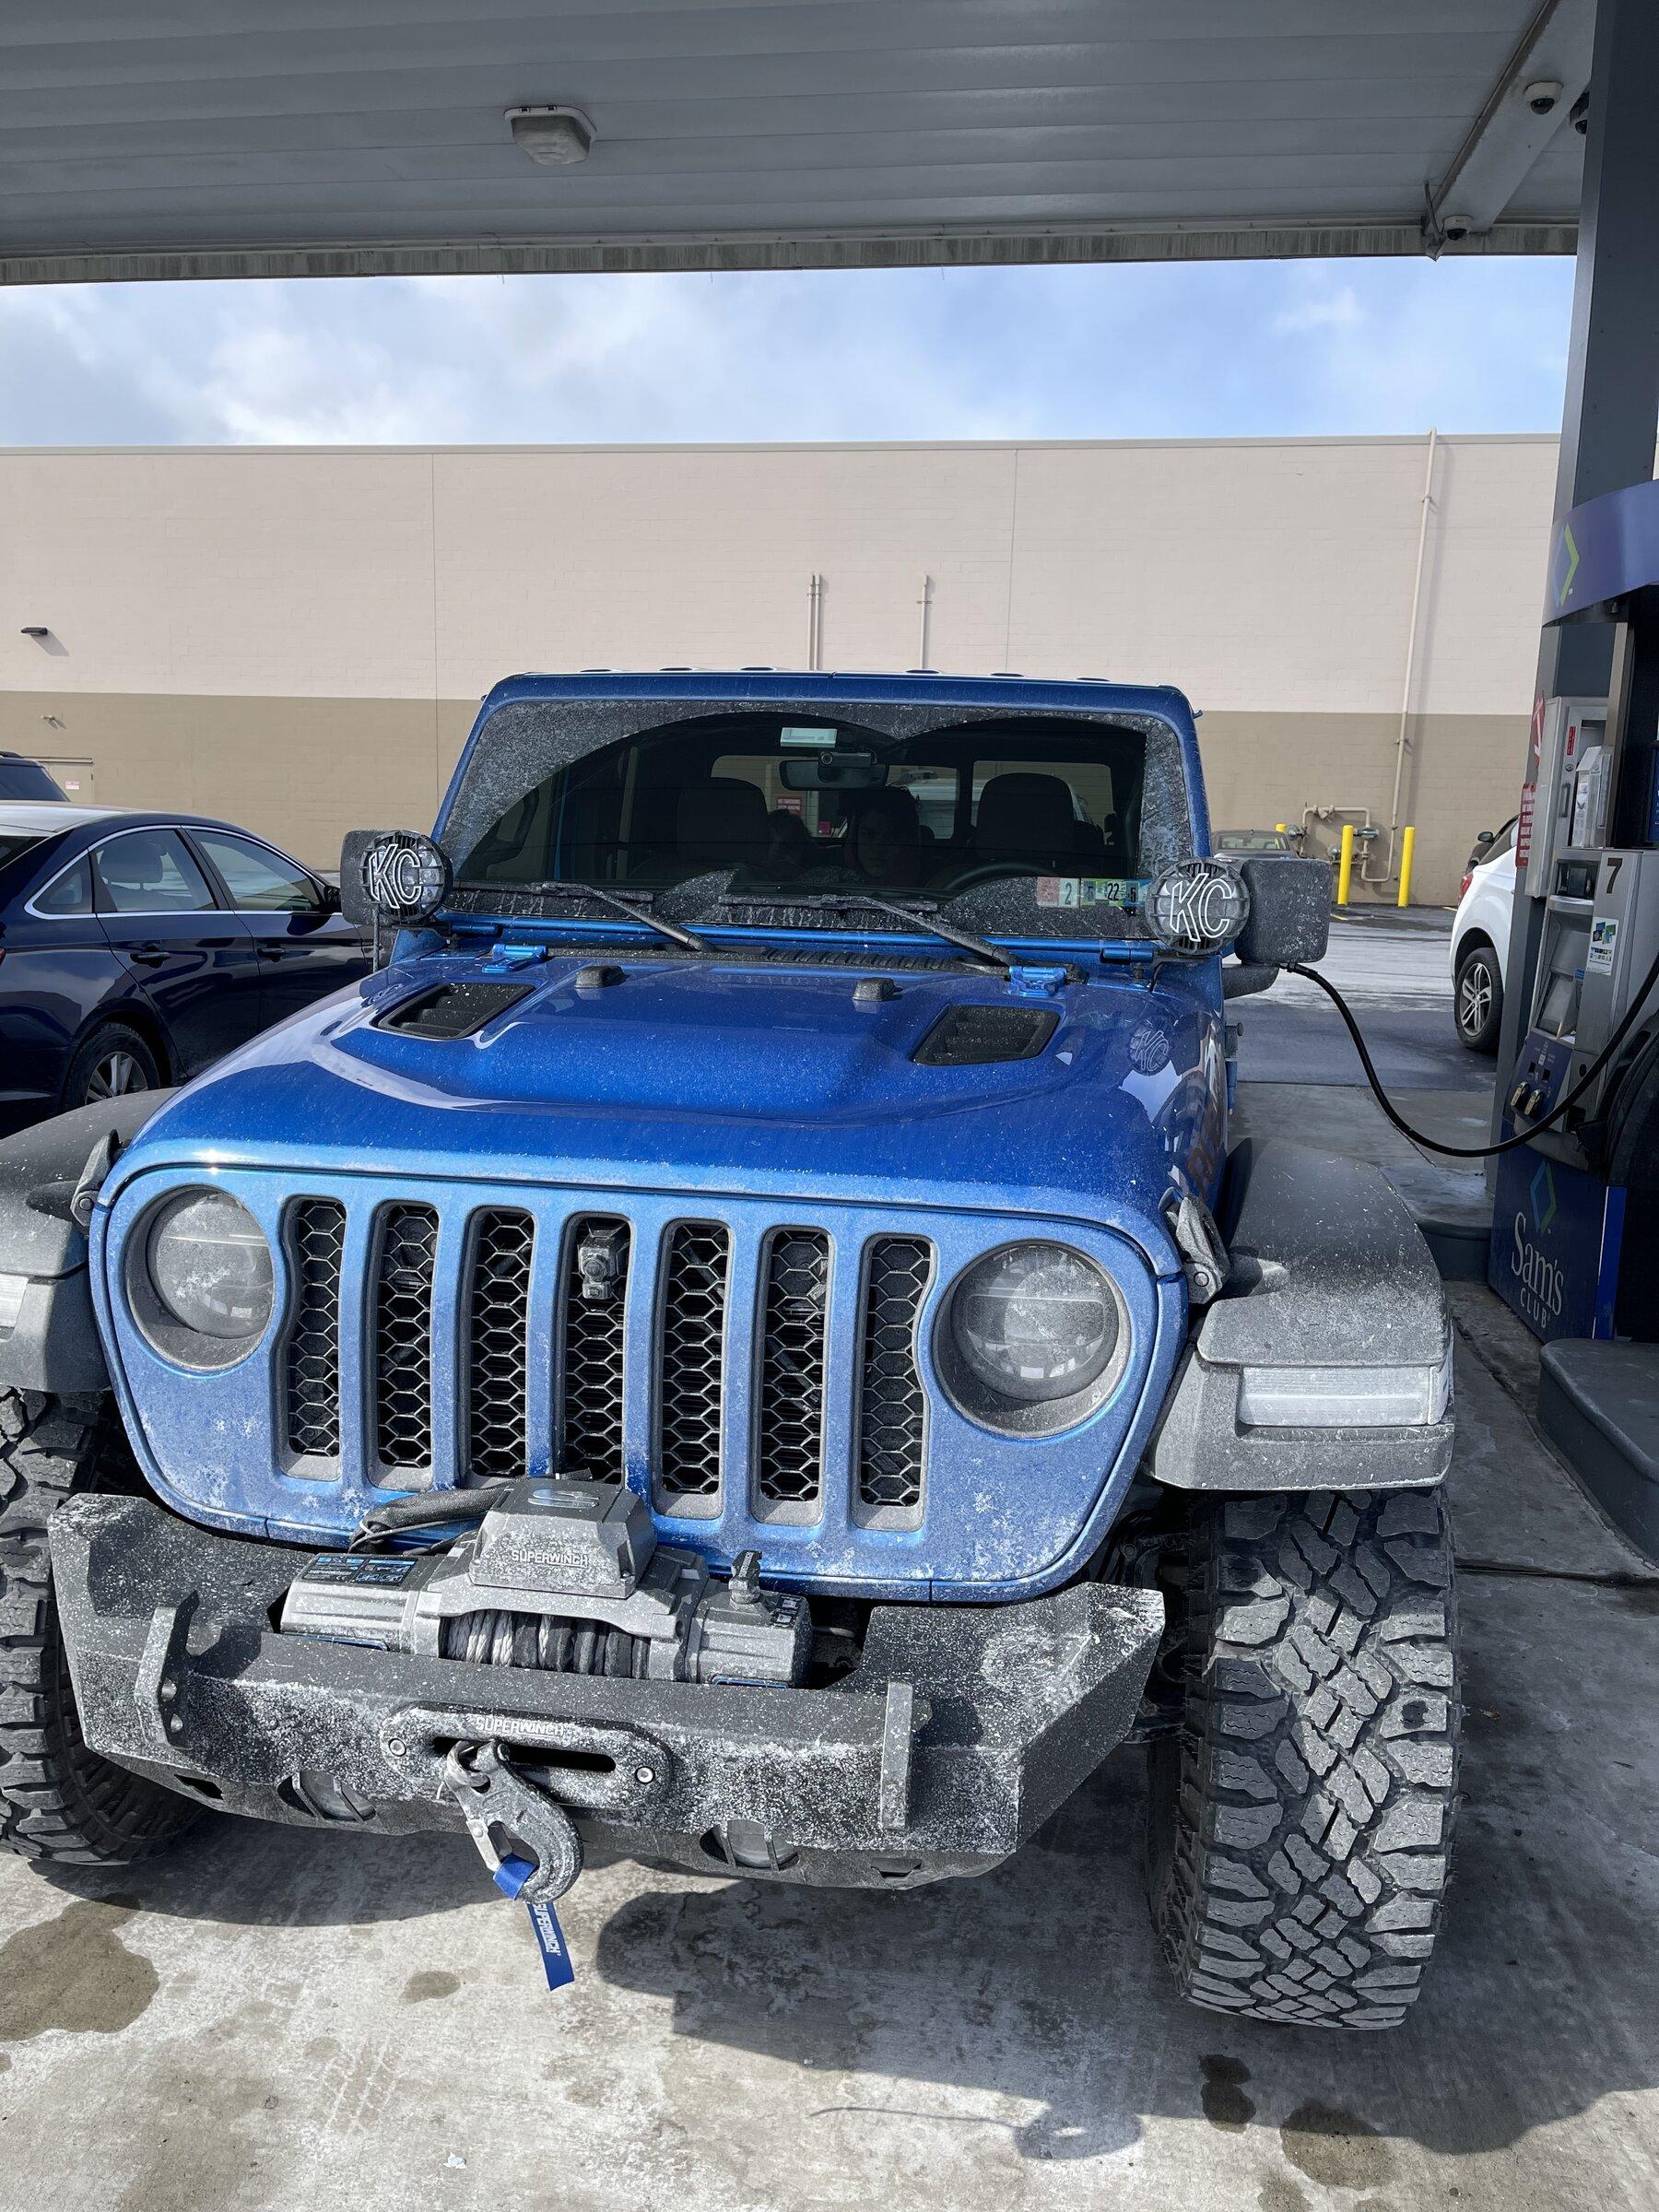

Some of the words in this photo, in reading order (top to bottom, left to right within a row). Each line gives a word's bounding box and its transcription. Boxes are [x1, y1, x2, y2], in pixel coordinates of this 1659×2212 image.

[369, 843, 422, 909] KC
[1107, 882, 1120, 900] 22
[1606, 857, 1624, 894] 7
[1170, 873, 1232, 942] KC
[1512, 1211, 1564, 1316] Sam's
[1520, 1288, 1547, 1328] CLUB
[511, 1549, 588, 1569] SUPERWINCH
[475, 1715, 565, 1740] SUPERWINCH
